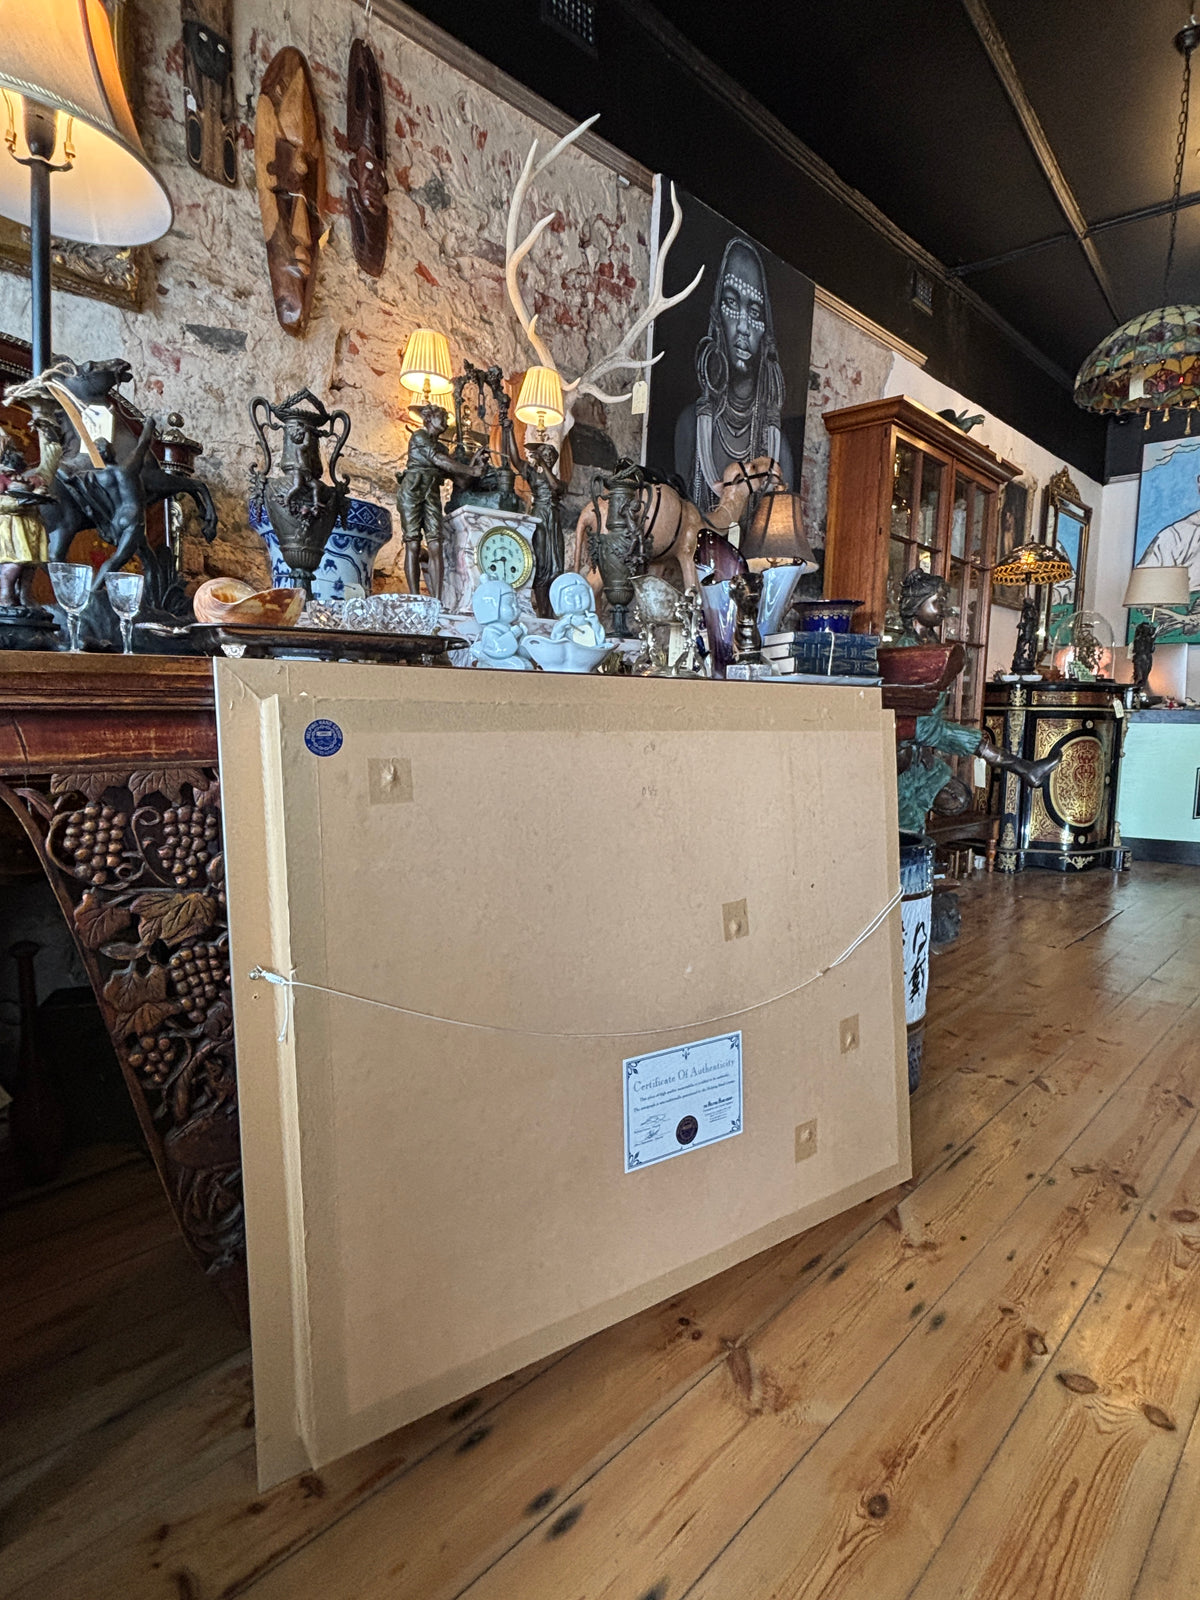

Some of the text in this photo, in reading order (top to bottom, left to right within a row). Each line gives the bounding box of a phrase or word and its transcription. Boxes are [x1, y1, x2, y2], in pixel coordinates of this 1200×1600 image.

[633, 1076, 676, 1093] Certificate
[677, 1069, 689, 1081] Of
[690, 1059, 734, 1078] Authenticity
